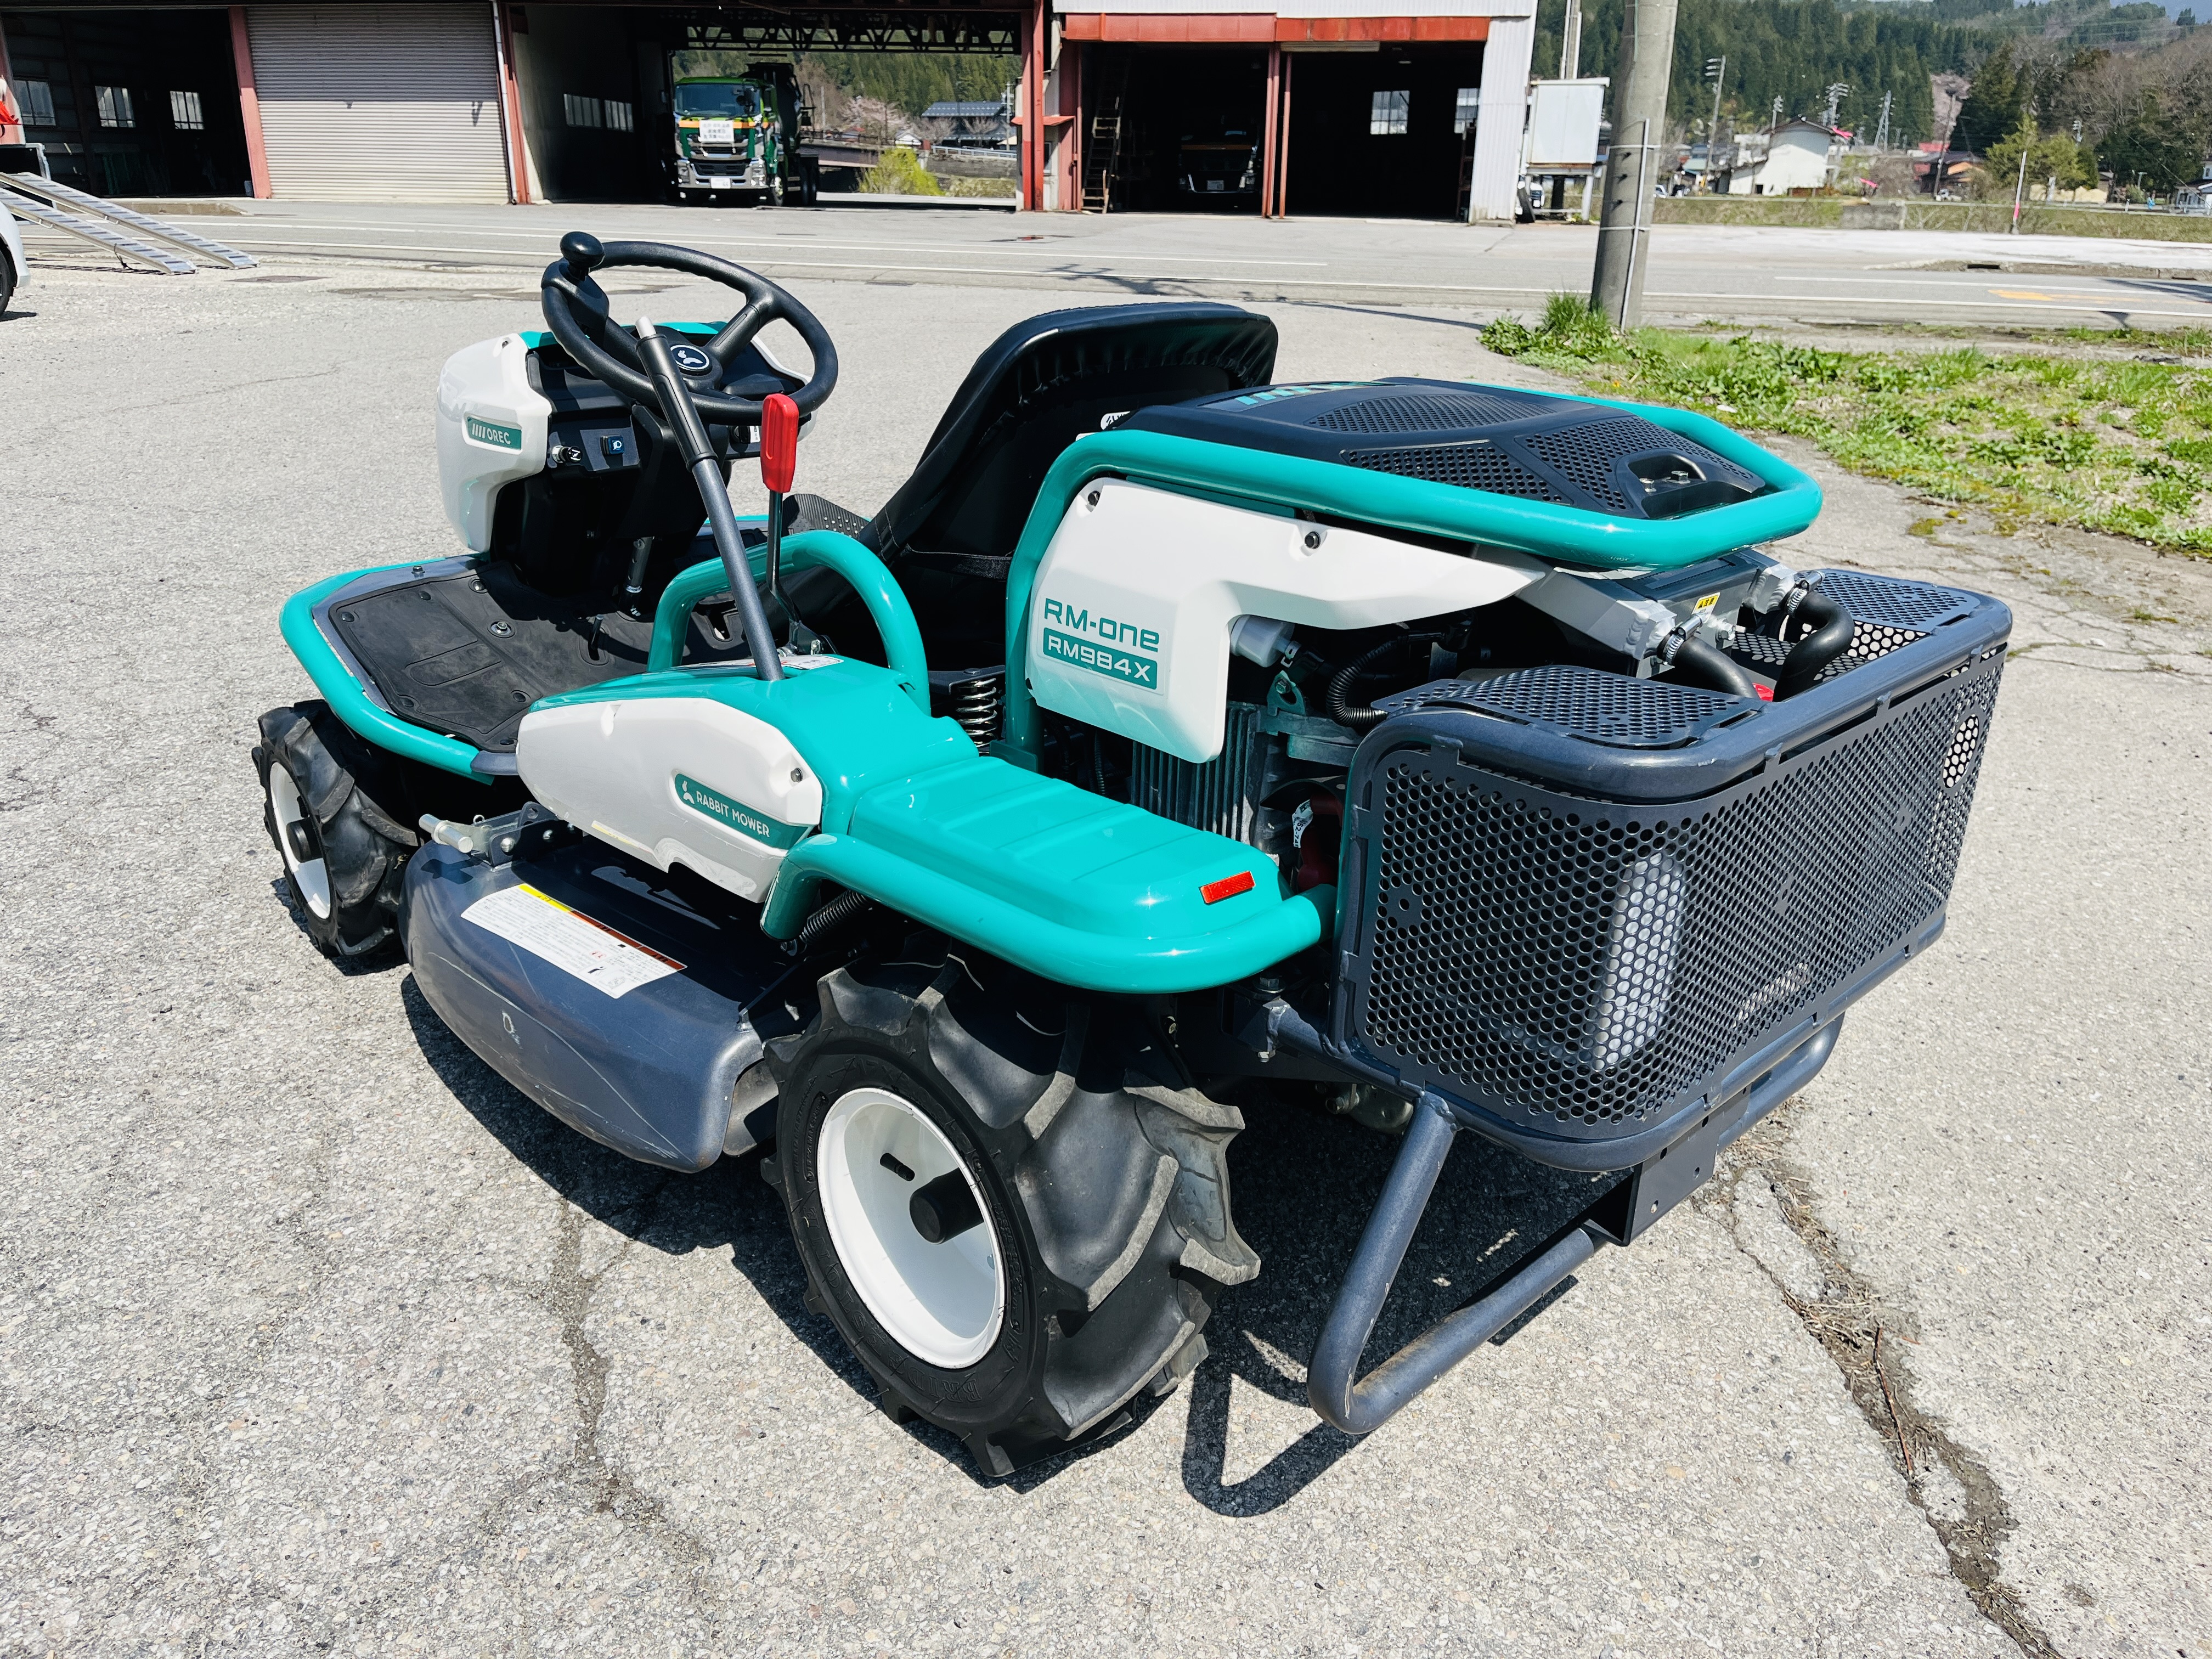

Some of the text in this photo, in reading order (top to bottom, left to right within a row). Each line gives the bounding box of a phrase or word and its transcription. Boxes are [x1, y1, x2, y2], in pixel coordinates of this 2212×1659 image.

[487, 428, 511, 445] OREC
[1044, 597, 1159, 653] RM-one
[1048, 635, 1151, 682] RM984X
[696, 791, 729, 817] RABBIT
[732, 808, 770, 838] MOWER
[799, 1205, 984, 1404] BRIDGESTONE
